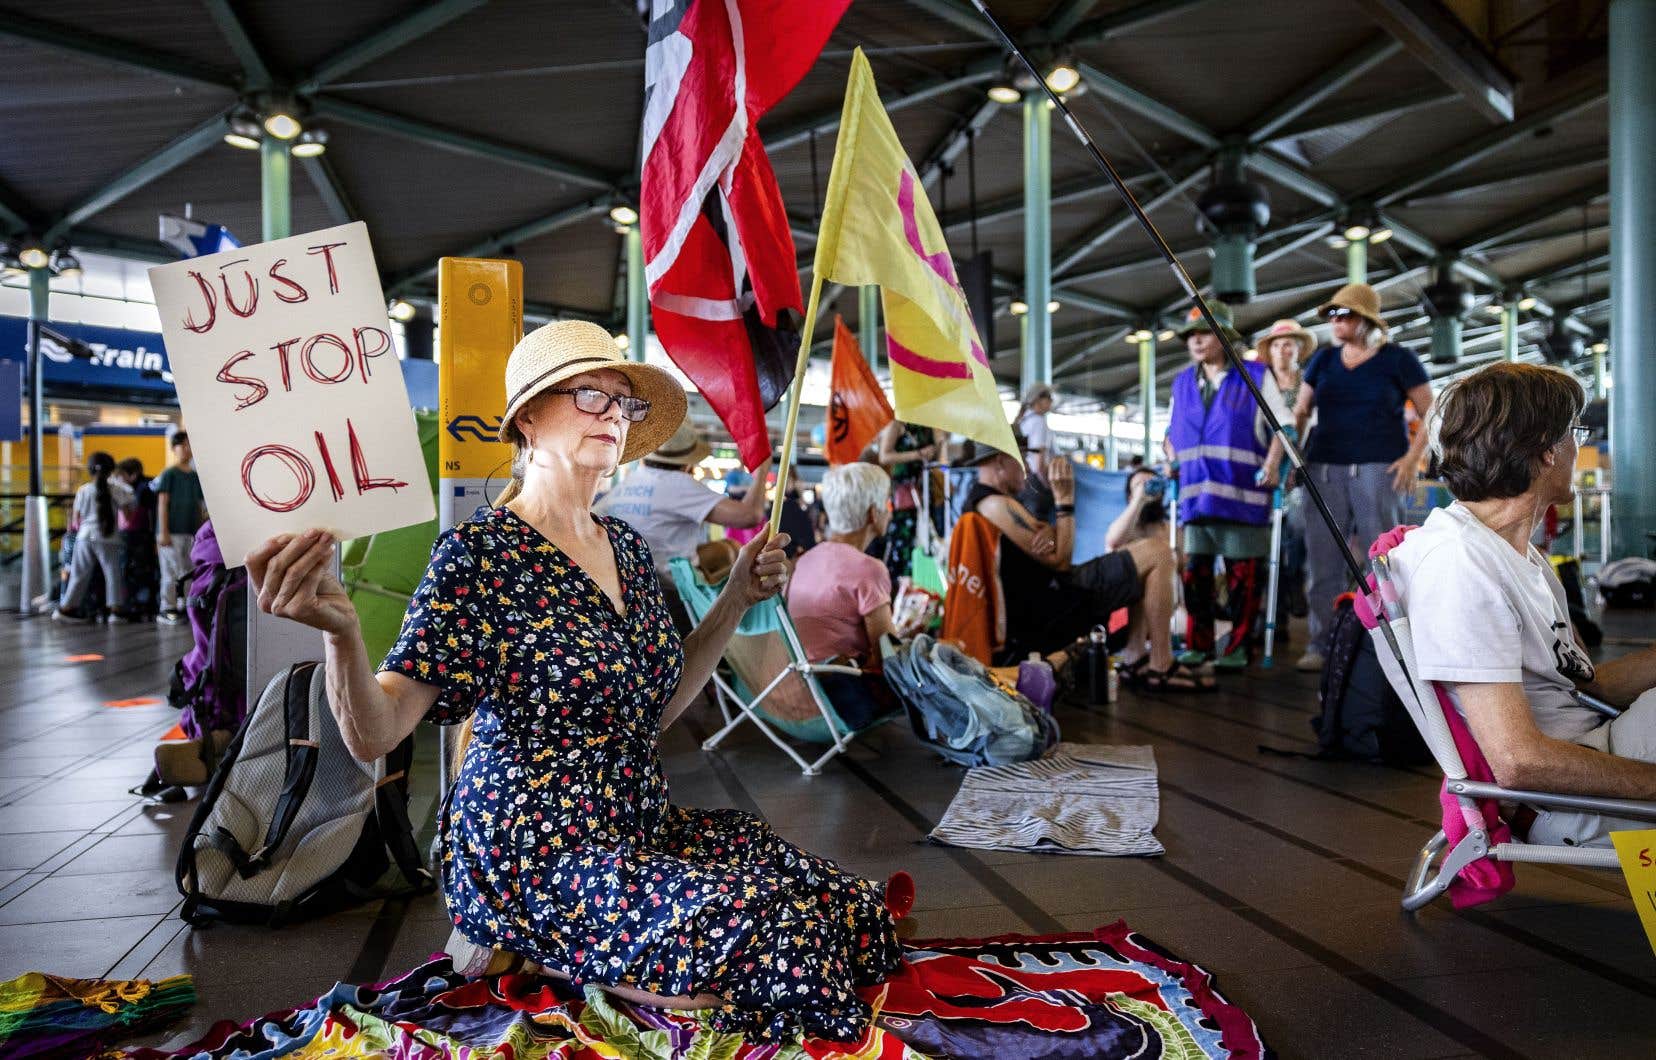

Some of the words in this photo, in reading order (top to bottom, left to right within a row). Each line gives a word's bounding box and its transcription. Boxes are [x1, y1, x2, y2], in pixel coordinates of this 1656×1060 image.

[183, 242, 347, 333] JUST
[216, 326, 390, 411] STOP
[241, 418, 408, 512] OIL
[445, 461, 460, 471] NS
